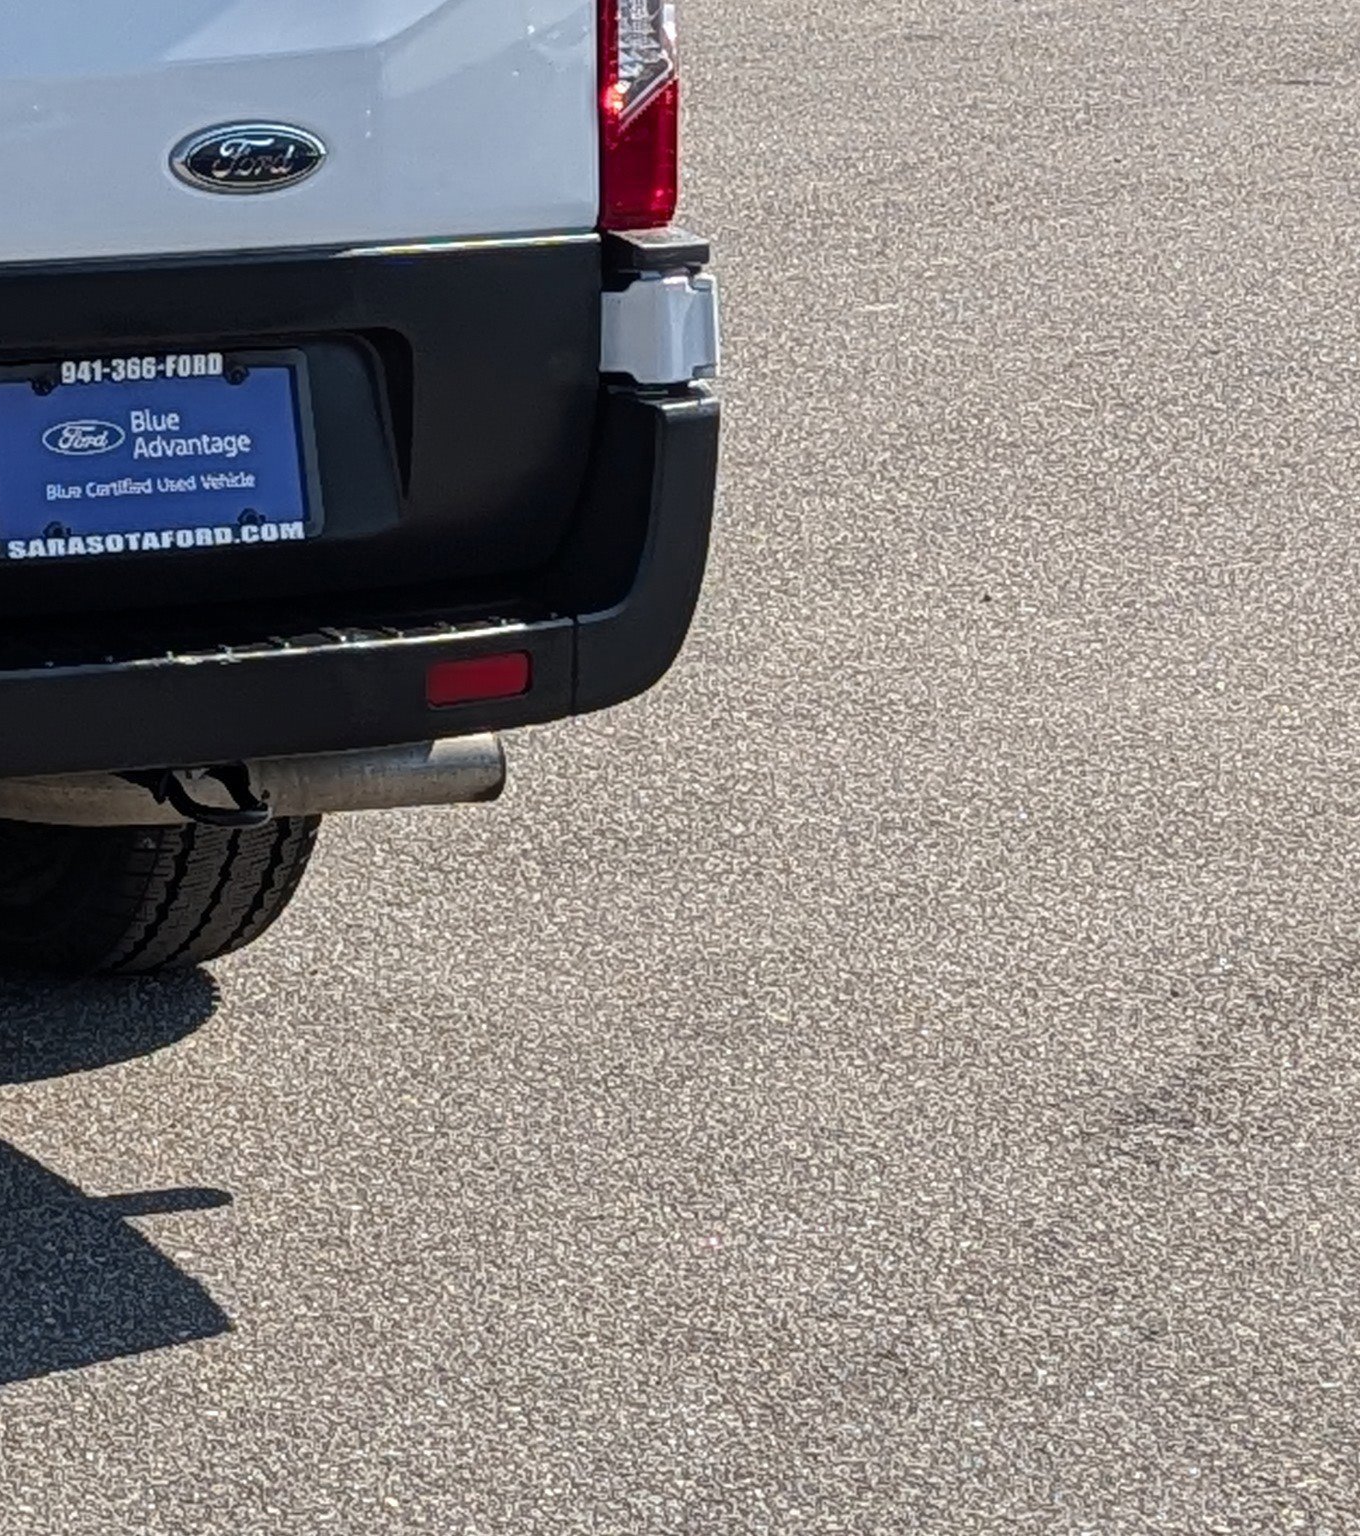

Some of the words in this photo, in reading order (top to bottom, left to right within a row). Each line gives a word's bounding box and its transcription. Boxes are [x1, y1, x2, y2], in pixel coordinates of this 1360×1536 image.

[211, 137, 293, 179] Ford
[61, 353, 224, 384] 941-366-FORD
[130, 409, 180, 433] Blue
[58, 425, 109, 449] Ford
[133, 434, 252, 460] Advantage
[46, 484, 82, 500] Blue
[85, 478, 153, 498] Certified
[156, 475, 197, 492] Used
[200, 470, 256, 490] Vehicle
[8, 521, 305, 560] SARASOTAFORD.COM
